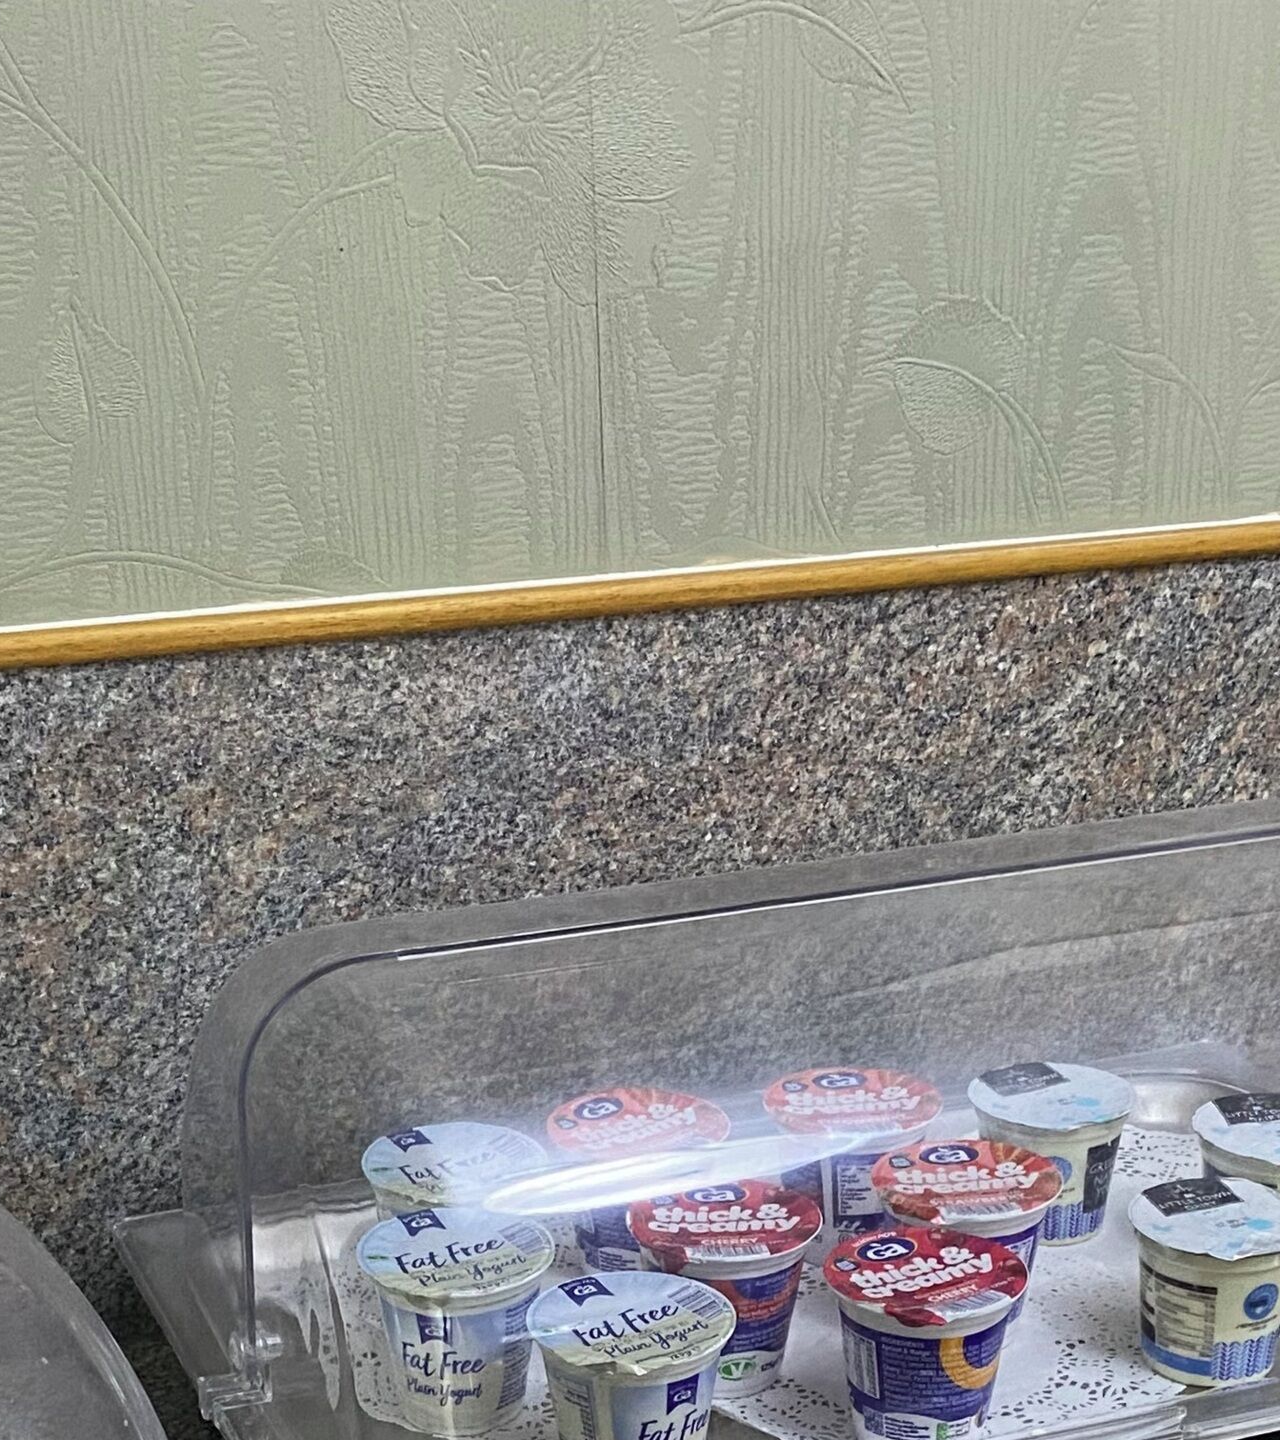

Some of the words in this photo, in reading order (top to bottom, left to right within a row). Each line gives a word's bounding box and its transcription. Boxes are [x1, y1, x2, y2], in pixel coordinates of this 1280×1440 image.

[783, 1096, 920, 1116] creamy
[785, 1090, 877, 1108] thick
[880, 1086, 909, 1100] &
[572, 1113, 649, 1142] thick
[648, 1103, 679, 1120] &
[398, 1164, 442, 1185] Fat
[894, 1166, 992, 1185] thick
[994, 1161, 1026, 1178] &
[894, 1172, 1040, 1195] creamy
[1159, 1195, 1195, 1210] LITTLE
[1196, 1191, 1232, 1201] TOWN
[648, 1216, 801, 1234] creamy
[652, 1206, 754, 1223] thick
[756, 1204, 790, 1221] &
[701, 1237, 759, 1247] CHERRY
[395, 1252, 447, 1275] Fat
[445, 1238, 506, 1265] Free
[850, 1256, 945, 1289] thick
[939, 1246, 976, 1265] &
[414, 1270, 466, 1288] Plain
[466, 1254, 528, 1281] Yogurt
[862, 1253, 993, 1299] creamy
[927, 1284, 978, 1303] CHERRY
[572, 1320, 626, 1347] Fat
[619, 1304, 680, 1334] Free
[603, 1338, 652, 1359] Plain
[651, 1319, 710, 1350] Yogurt
[401, 1340, 436, 1377] Fat
[439, 1350, 488, 1381] Free
[406, 1376, 438, 1397] Plain
[439, 1382, 483, 1407] Yogurt
